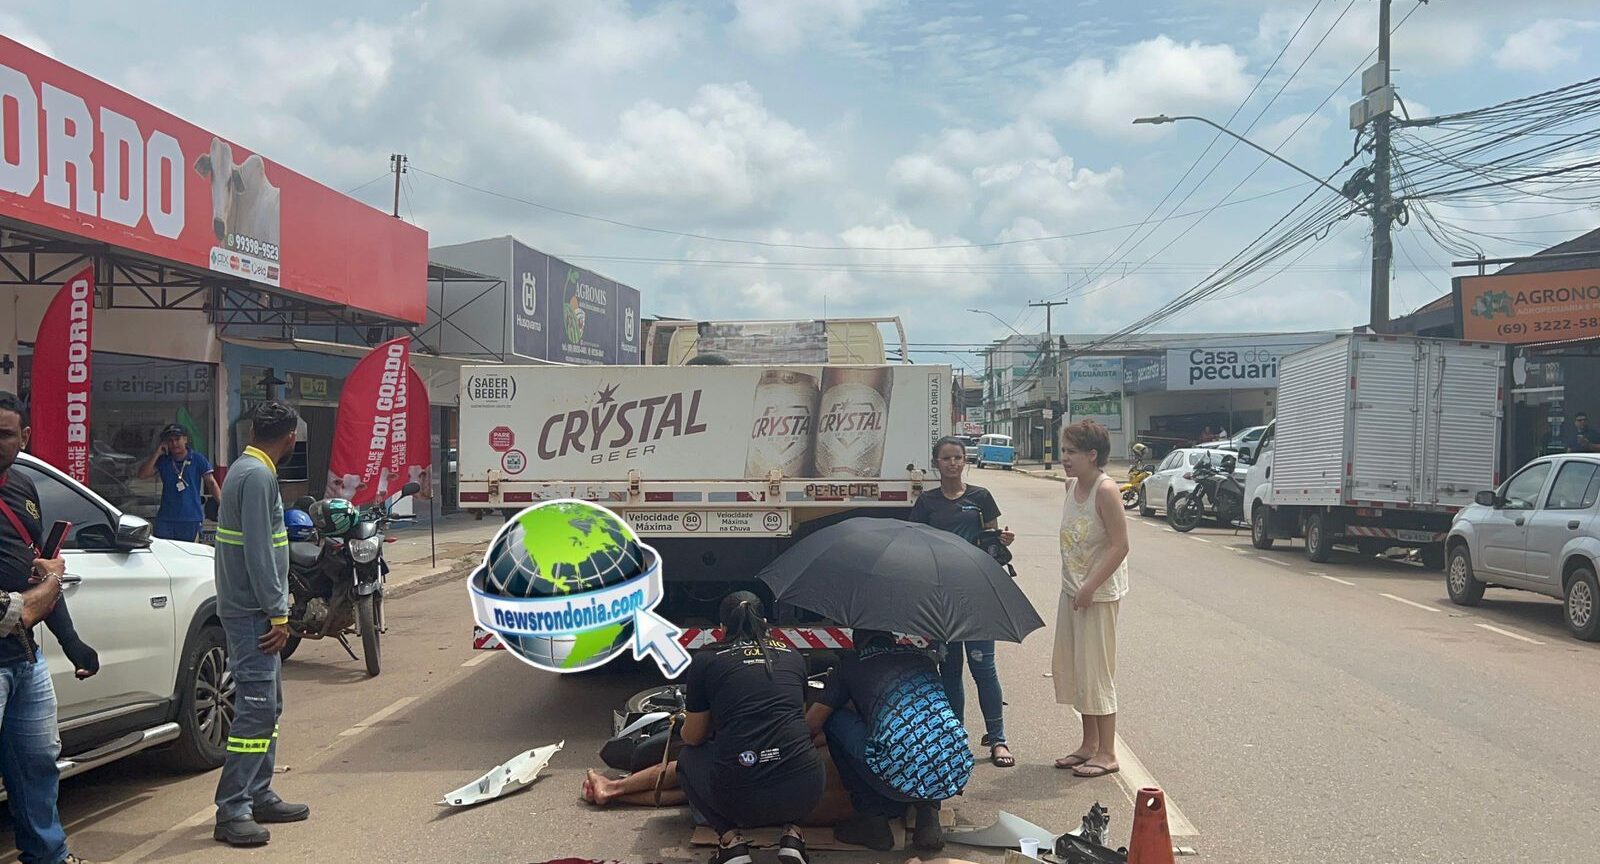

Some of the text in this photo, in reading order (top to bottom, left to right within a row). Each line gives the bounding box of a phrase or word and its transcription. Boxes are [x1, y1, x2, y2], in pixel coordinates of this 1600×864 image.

[235, 234, 279, 260] 99398-9523
[575, 282, 607, 306] AGROMIS
[1497, 323, 1527, 336] (69)
[67, 279, 89, 443] BOI GORDO
[1189, 348, 1238, 365] Casa
[376, 344, 404, 411] GORDO
[1189, 356, 1278, 385] pecuari
[474, 377, 508, 388] SABER
[474, 388, 508, 399] BEBER
[391, 411, 407, 443] BOI
[537, 389, 707, 461] CRYSTAL
[819, 411, 882, 433] CRYSTAL
[929, 407, 939, 426] NÃO
[370, 415, 391, 450] BOI
[67, 446, 75, 460] DE
[391, 454, 399, 473] CASA
[590, 445, 656, 465] BEER
[75, 446, 86, 483] CARNE
[362, 450, 377, 483] CASA DE
[628, 513, 698, 523] Velocidade 80
[635, 522, 673, 531] Máxima
[766, 515, 778, 523] 60
